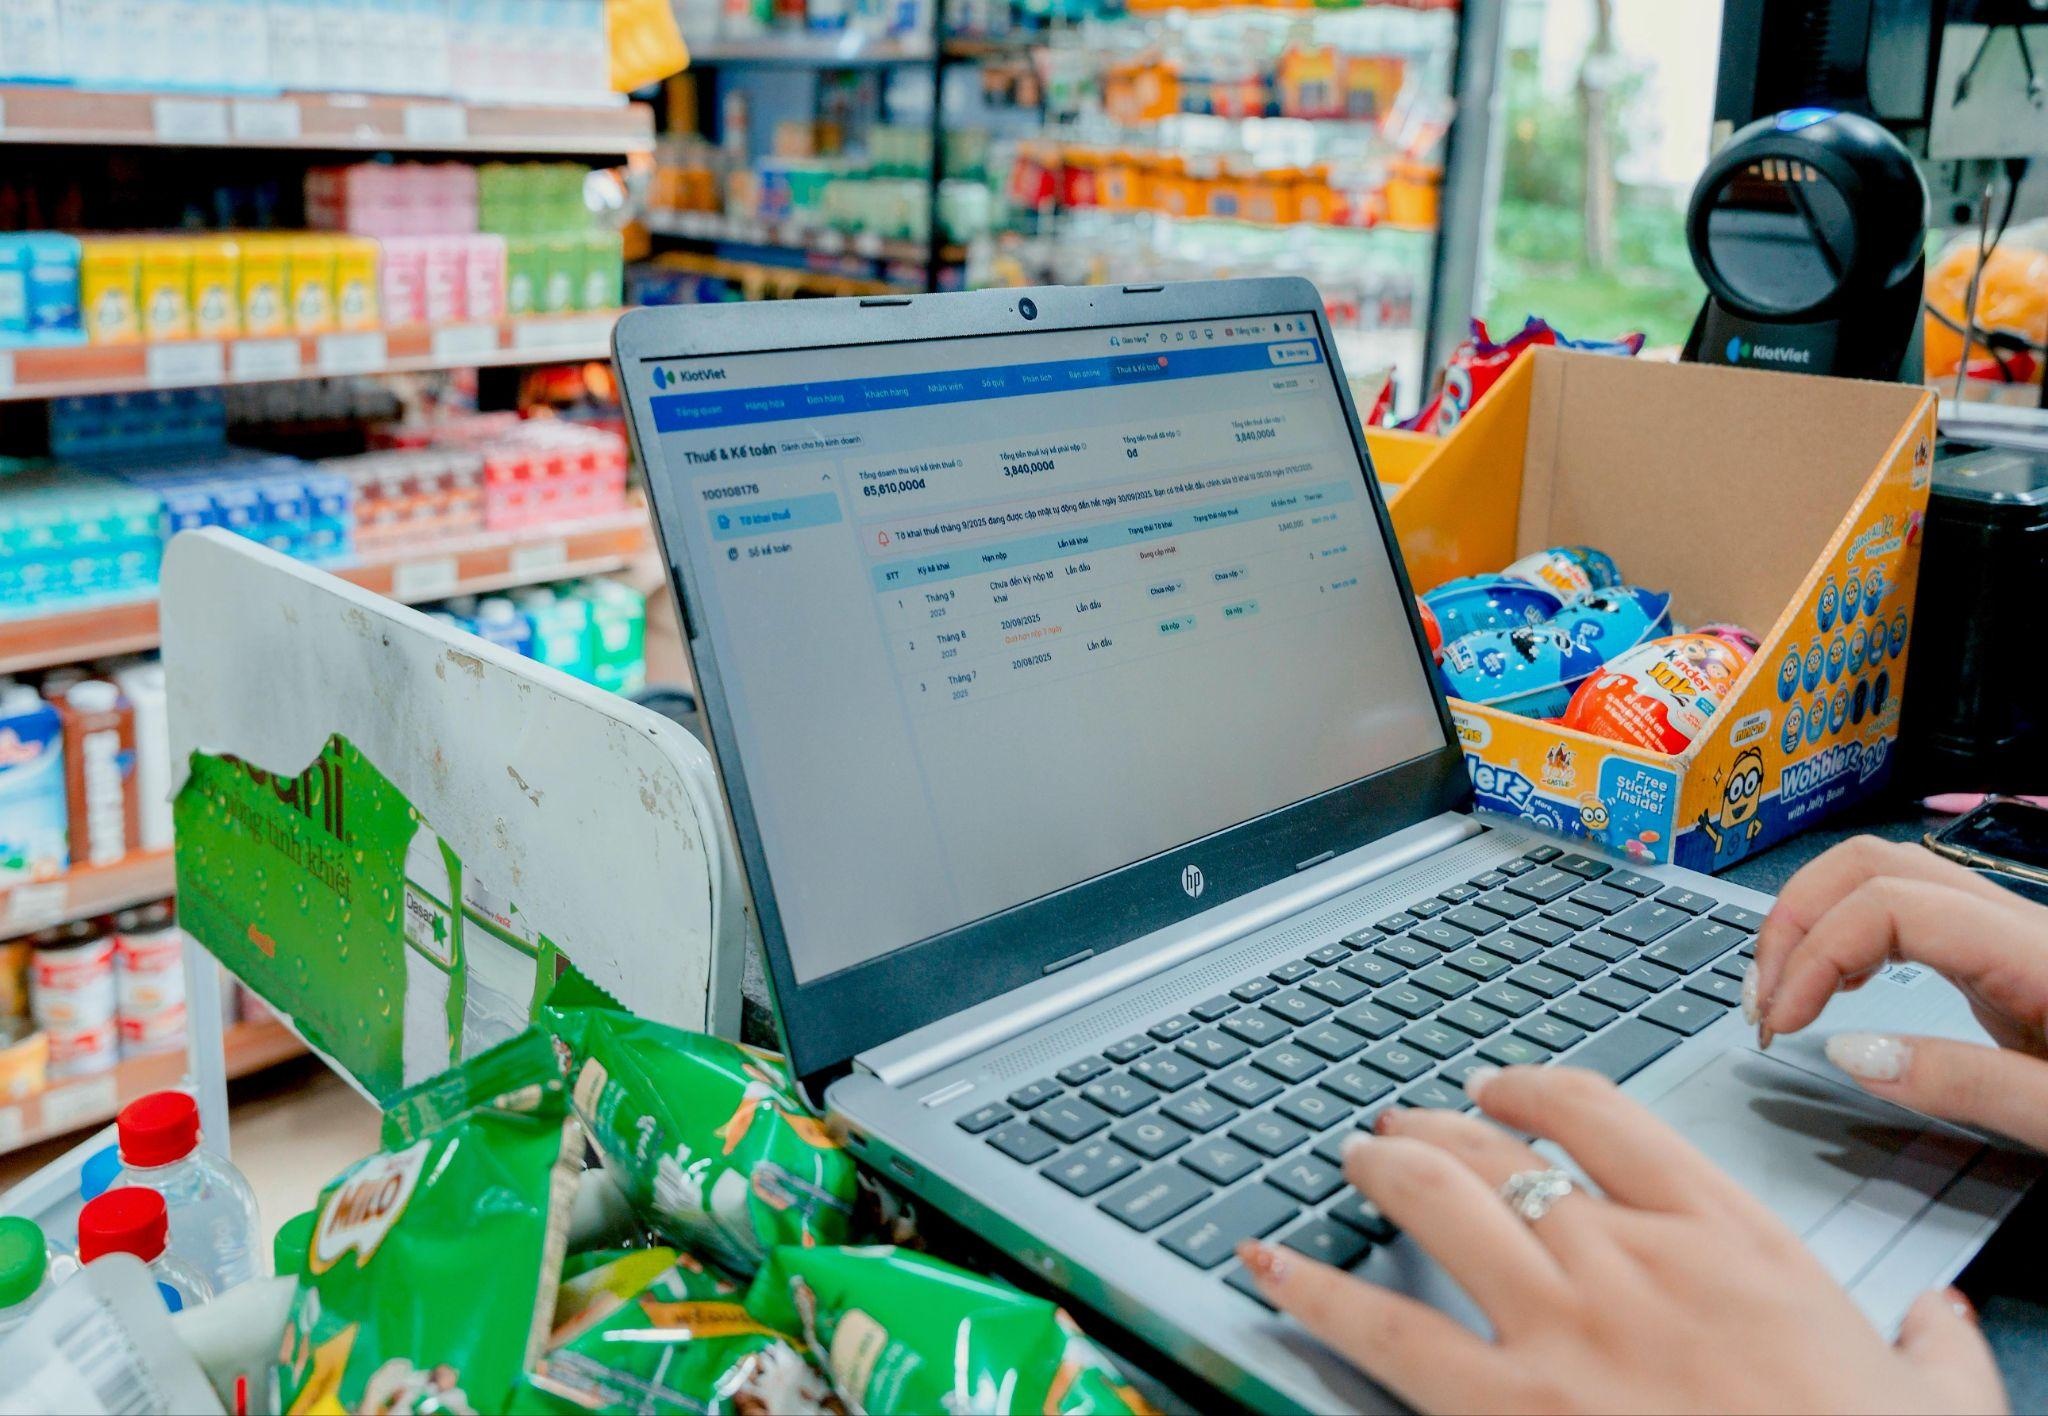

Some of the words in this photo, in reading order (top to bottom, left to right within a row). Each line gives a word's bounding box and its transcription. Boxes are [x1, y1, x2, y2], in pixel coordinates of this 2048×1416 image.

[1753, 344, 1810, 363] KiotViet
[680, 368, 726, 381] KiotViet
[864, 389, 889, 398] Khách
[889, 388, 909, 396] hàng
[780, 443, 799, 451] Dành
[800, 441, 813, 449] cho
[813, 440, 824, 448] hộ
[824, 438, 839, 446] kinh
[839, 436, 861, 444] doanh
[684, 449, 717, 463] Thuế
[719, 448, 728, 460] &
[729, 445, 747, 458] Kế
[748, 443, 776, 456] toán
[1126, 448, 1138, 458] 0đ
[1003, 460, 1055, 477] 3,840,000đ
[701, 483, 759, 499] 100108176
[863, 478, 926, 496] 65,610,000đ
[894, 531, 906, 540] Tờ
[906, 528, 922, 538] khai
[922, 523, 939, 535] thuế
[940, 523, 961, 533] tháng
[961, 517, 987, 529] 9/2025
[987, 516, 1005, 525] đang
[1005, 512, 1023, 521] được
[981, 554, 995, 563] Hạn
[994, 551, 1008, 560] nộp
[1064, 564, 1078, 575] Lần
[1078, 562, 1091, 572] đầu
[989, 580, 1008, 590] Chưa
[1008, 576, 1022, 586] đến
[1022, 575, 1031, 584] kỳ
[1031, 572, 1046, 581] nộp
[1045, 570, 1054, 578] tờ
[925, 592, 949, 602] Tháng
[1149, 587, 1165, 595] Chưa
[1164, 584, 1176, 592] nộp
[992, 594, 1009, 603] khai
[1075, 602, 1089, 613] Lần
[1088, 600, 1101, 609] đầu
[928, 607, 946, 618] 2025
[1000, 613, 1041, 629] 20/09/2025
[936, 632, 960, 643] Tháng
[1086, 641, 1099, 651] Lần
[1099, 637, 1113, 647] đầu
[947, 673, 971, 684] Tháng
[1664, 650, 1712, 692] Kinder
[1781, 741, 1862, 801] Wobblerz
[1616, 775, 1667, 804] Sticker
[1636, 770, 1669, 793] Free
[1616, 788, 1665, 816] Inside!
[1788, 803, 1805, 820] with
[1827, 787, 1845, 802] Bean
[1186, 866, 1201, 900] hp
[406, 892, 438, 926] Dasan
[326, 1172, 404, 1238] MILO
